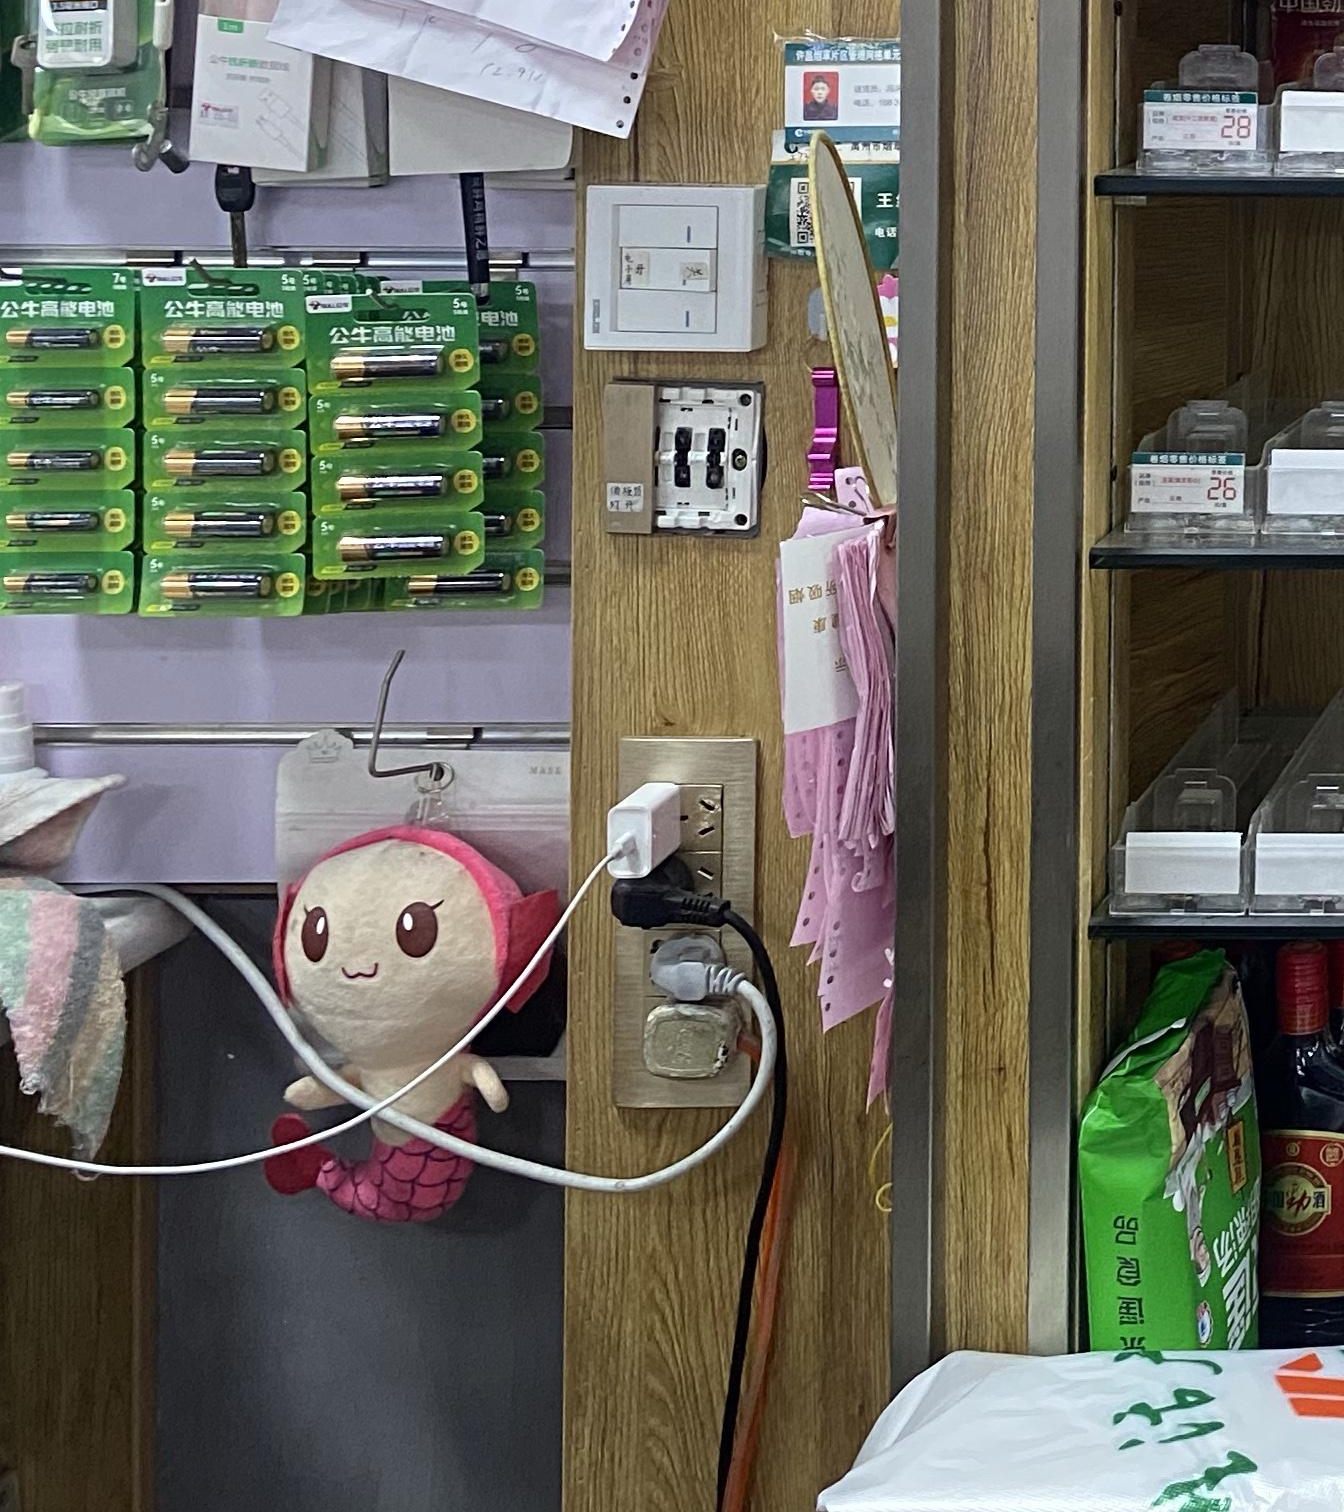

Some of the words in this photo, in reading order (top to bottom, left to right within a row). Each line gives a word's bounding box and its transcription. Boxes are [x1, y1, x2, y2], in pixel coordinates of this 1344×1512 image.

[1220, 114, 1251, 140] 28
[1, 300, 115, 319] 公牛高能电池
[164, 300, 285, 319] 公牛高能电池
[329, 326, 456, 345] 公牛高能电池
[1206, 477, 1237, 501] 26
